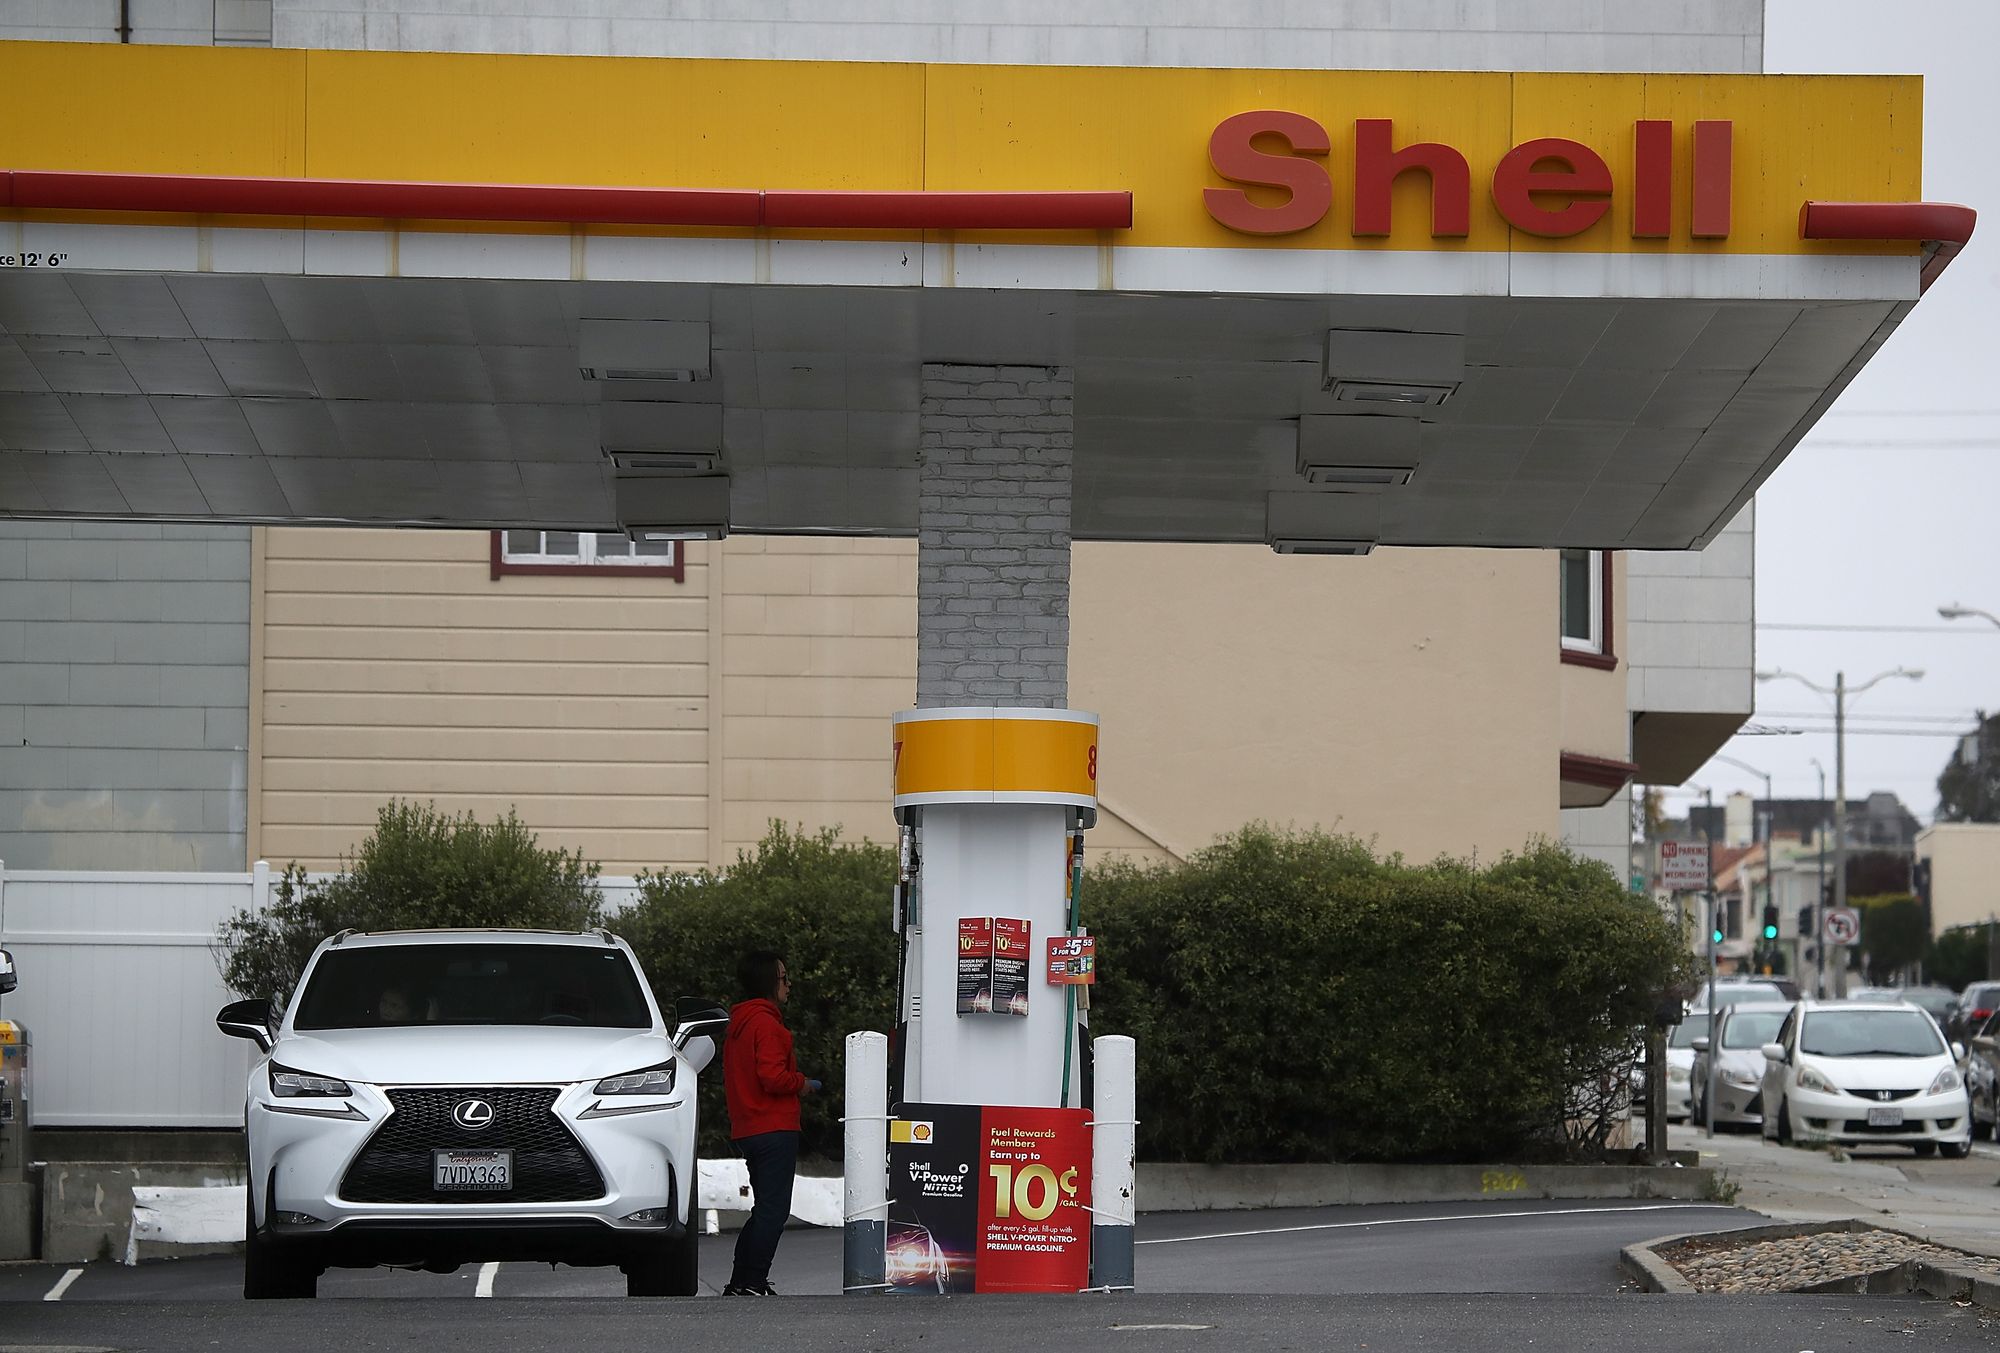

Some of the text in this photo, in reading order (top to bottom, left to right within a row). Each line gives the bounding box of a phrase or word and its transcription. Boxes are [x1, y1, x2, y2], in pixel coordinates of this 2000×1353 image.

[1203, 109, 1733, 238] Shell
[20, 253, 42, 266] 12'
[48, 253, 67, 266] 6"
[1088, 745, 1096, 780] 8
[1663, 844, 1707, 857] NO PARKING
[1051, 947, 1058, 955] 3
[991, 1127, 1056, 1138] Fuel Rewards
[990, 1138, 1036, 1148] Members
[990, 1150, 1041, 1161] Earn up to
[909, 1162, 930, 1171] Shell
[439, 1166, 507, 1183] 7VDX363
[909, 1171, 964, 1183] V-Power
[987, 1222, 1002, 1231] after
[1042, 1225, 1058, 1234] fill-up
[987, 1233, 1008, 1241] SHELL
[986, 1243, 1065, 1252] PREMIUM GASOLINE.
